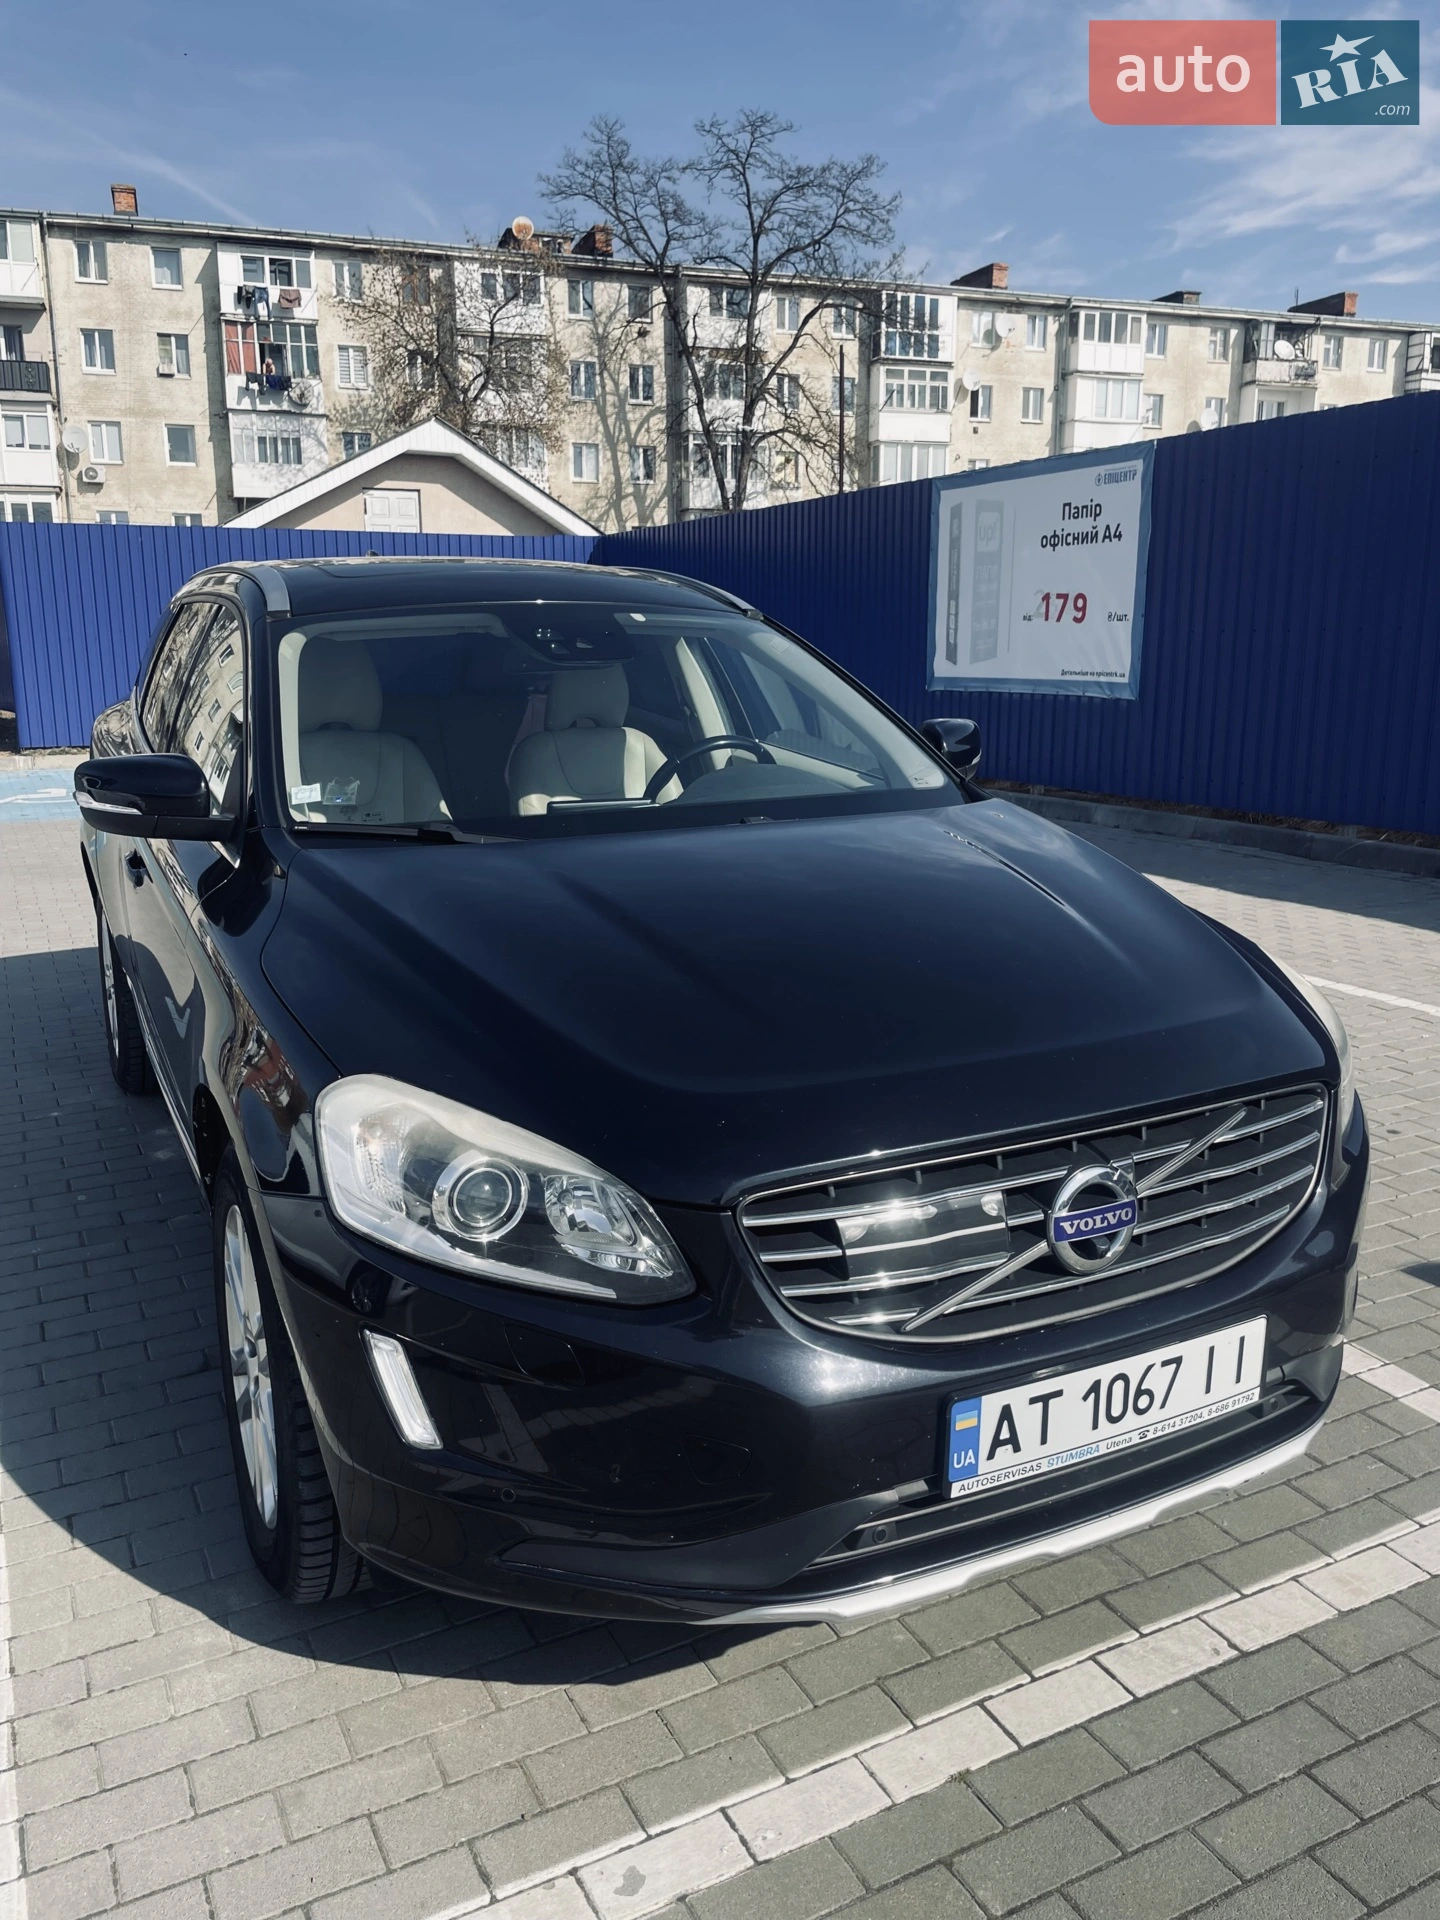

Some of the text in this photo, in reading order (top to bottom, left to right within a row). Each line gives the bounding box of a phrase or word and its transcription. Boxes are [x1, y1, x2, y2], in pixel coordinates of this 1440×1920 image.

[1062, 498, 1102, 522] Папір
[1041, 525, 1098, 552] офісний
[1042, 592, 1088, 624] 179
[1060, 1207, 1132, 1235] VOLVO
[986, 1388, 1064, 1461] AT
[1082, 1355, 1184, 1431] 1067
[958, 1462, 1042, 1493] AUTOSERVISAS
[1046, 1444, 1100, 1468] STUMBRA
[1106, 1435, 1133, 1450] Utena
[1152, 1420, 1177, 1435] 8-614
[1207, 1403, 1230, 1416] 8-686
[1231, 1392, 1255, 1408] 91792
[953, 1448, 976, 1469] UA
